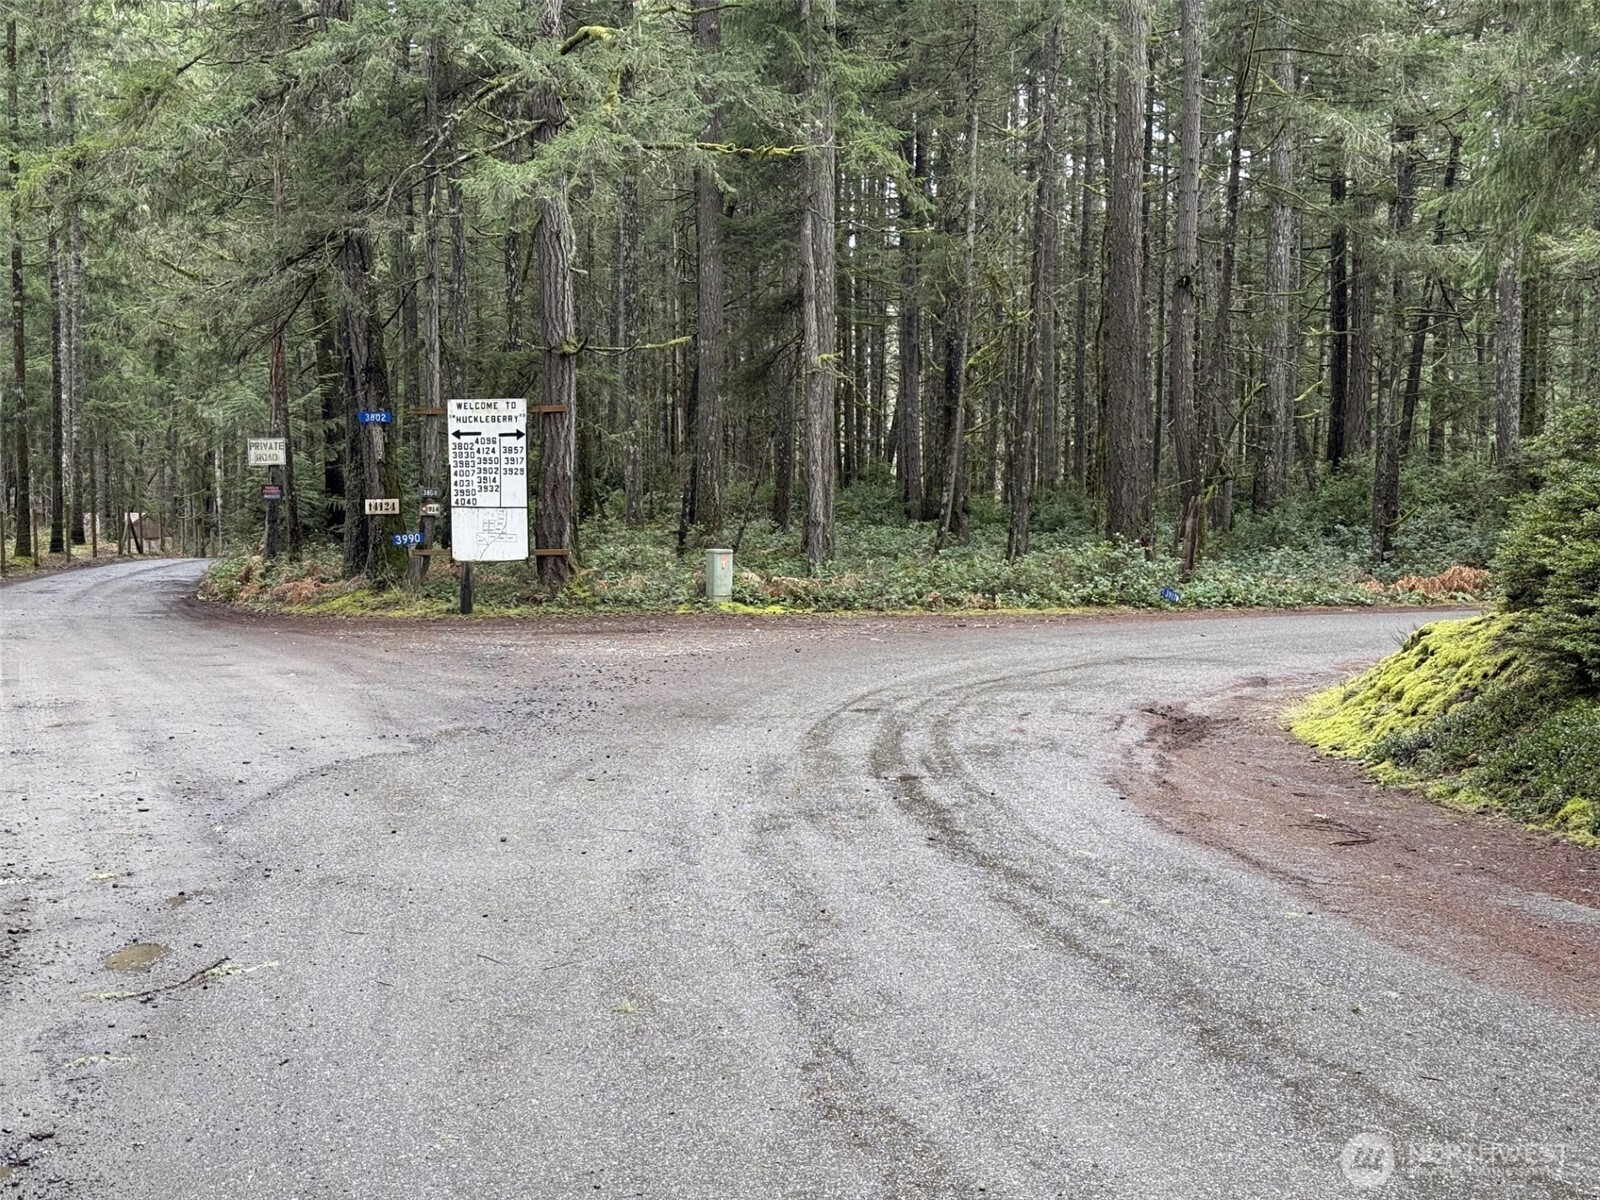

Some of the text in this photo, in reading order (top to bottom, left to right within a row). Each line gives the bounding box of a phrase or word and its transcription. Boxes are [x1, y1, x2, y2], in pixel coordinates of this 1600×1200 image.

[456, 402, 517, 410] WELCOME TO
[365, 413, 387, 422] 3802
[475, 437, 497, 445] 4096
[249, 442, 285, 451] PRIVATE
[452, 442, 475, 451] 3802
[502, 446, 524, 454] 3857
[452, 451, 476, 459] 3830
[476, 447, 496, 455] 4124
[256, 454, 278, 462] ROAD
[476, 457, 499, 465] 3950
[504, 457, 524, 465] 3917
[453, 460, 476, 468] 3983
[453, 469, 475, 478] 4007
[476, 467, 499, 475] 3902
[503, 468, 525, 476] 3929
[453, 480, 474, 488] 4031
[477, 476, 497, 484] 3914
[453, 489, 477, 497] 3990
[477, 485, 500, 493] 3932
[454, 498, 477, 506] 4040
[395, 533, 421, 545] 3990
